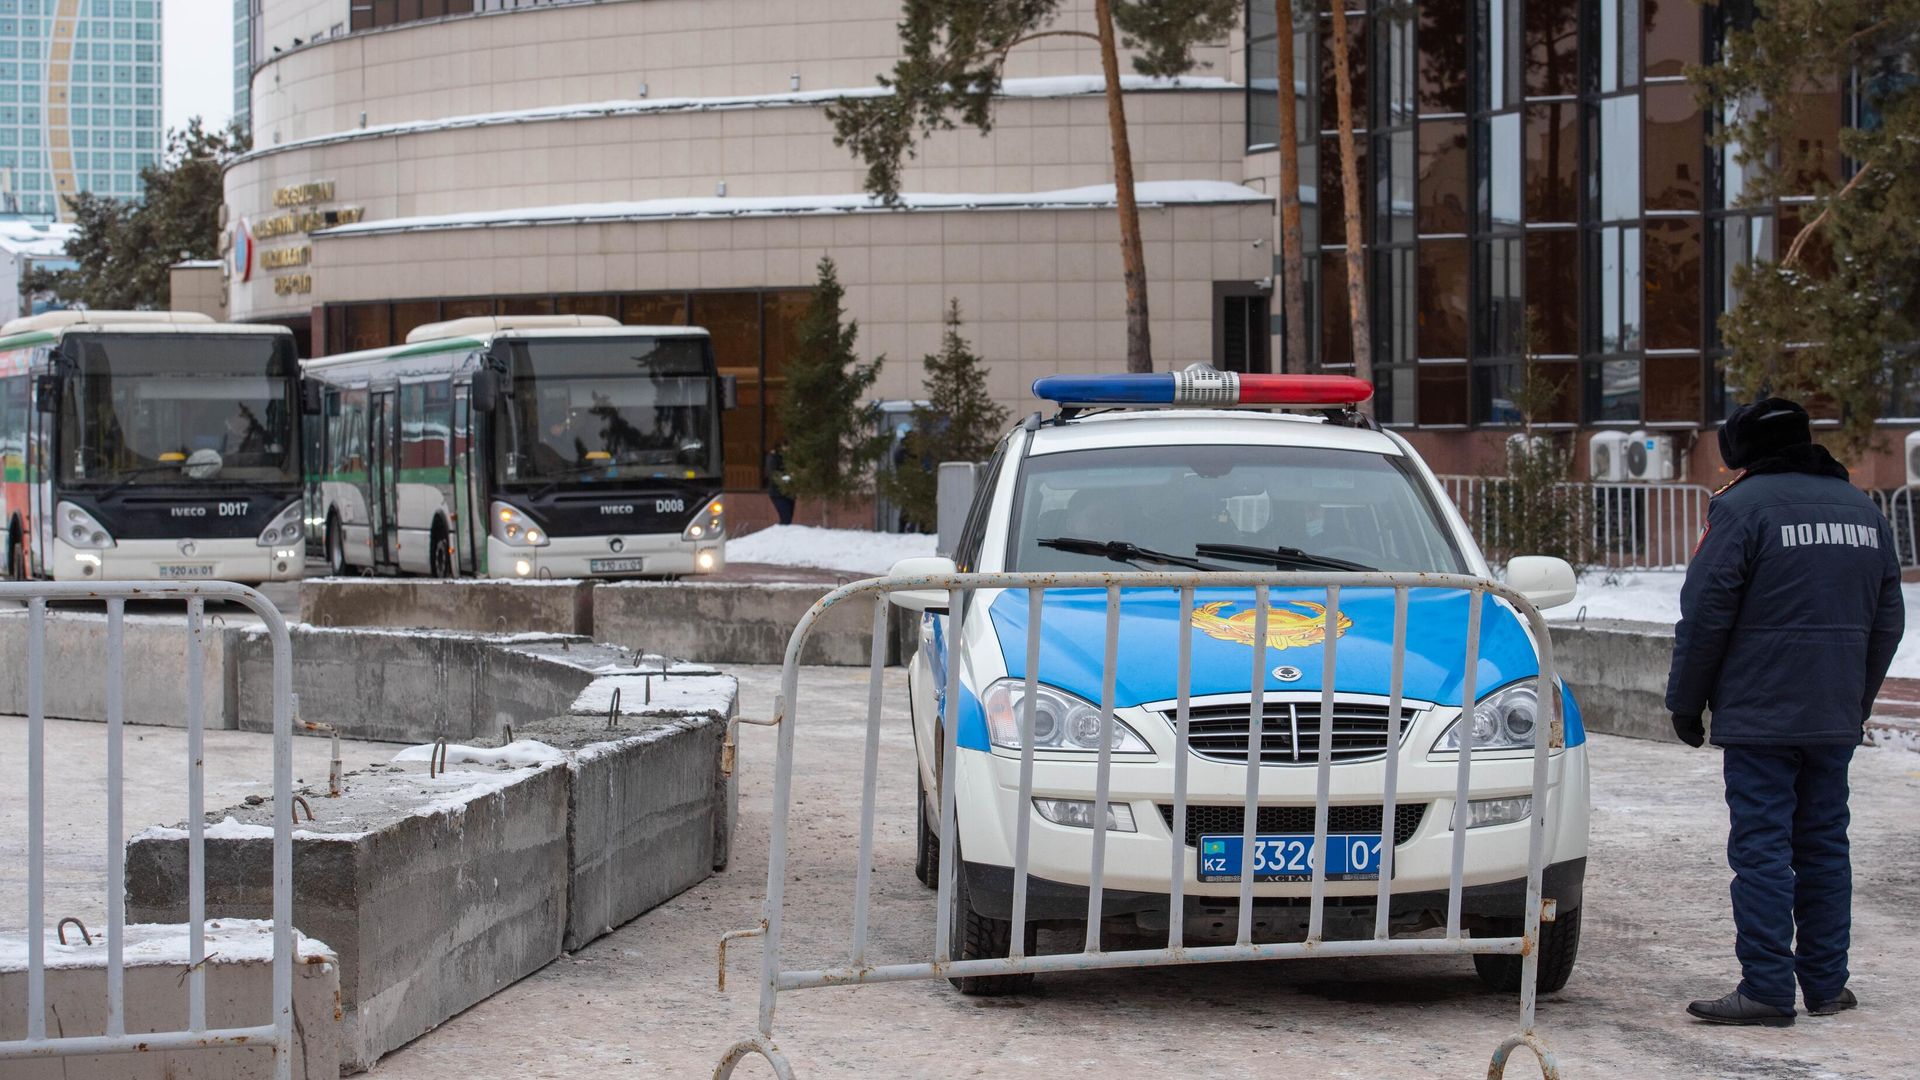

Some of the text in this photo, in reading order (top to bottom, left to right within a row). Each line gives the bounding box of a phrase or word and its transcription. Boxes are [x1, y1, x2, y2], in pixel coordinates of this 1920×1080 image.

[171, 507, 206, 517] IVECO
[219, 503, 248, 516] D017
[600, 505, 634, 514] IVECO
[656, 500, 684, 513] D008
[1781, 523, 1879, 549] ПОЛИЦИЯ
[169, 565, 186, 576] 920
[201, 565, 213, 576] 01
[1204, 858, 1226, 871] KZ
